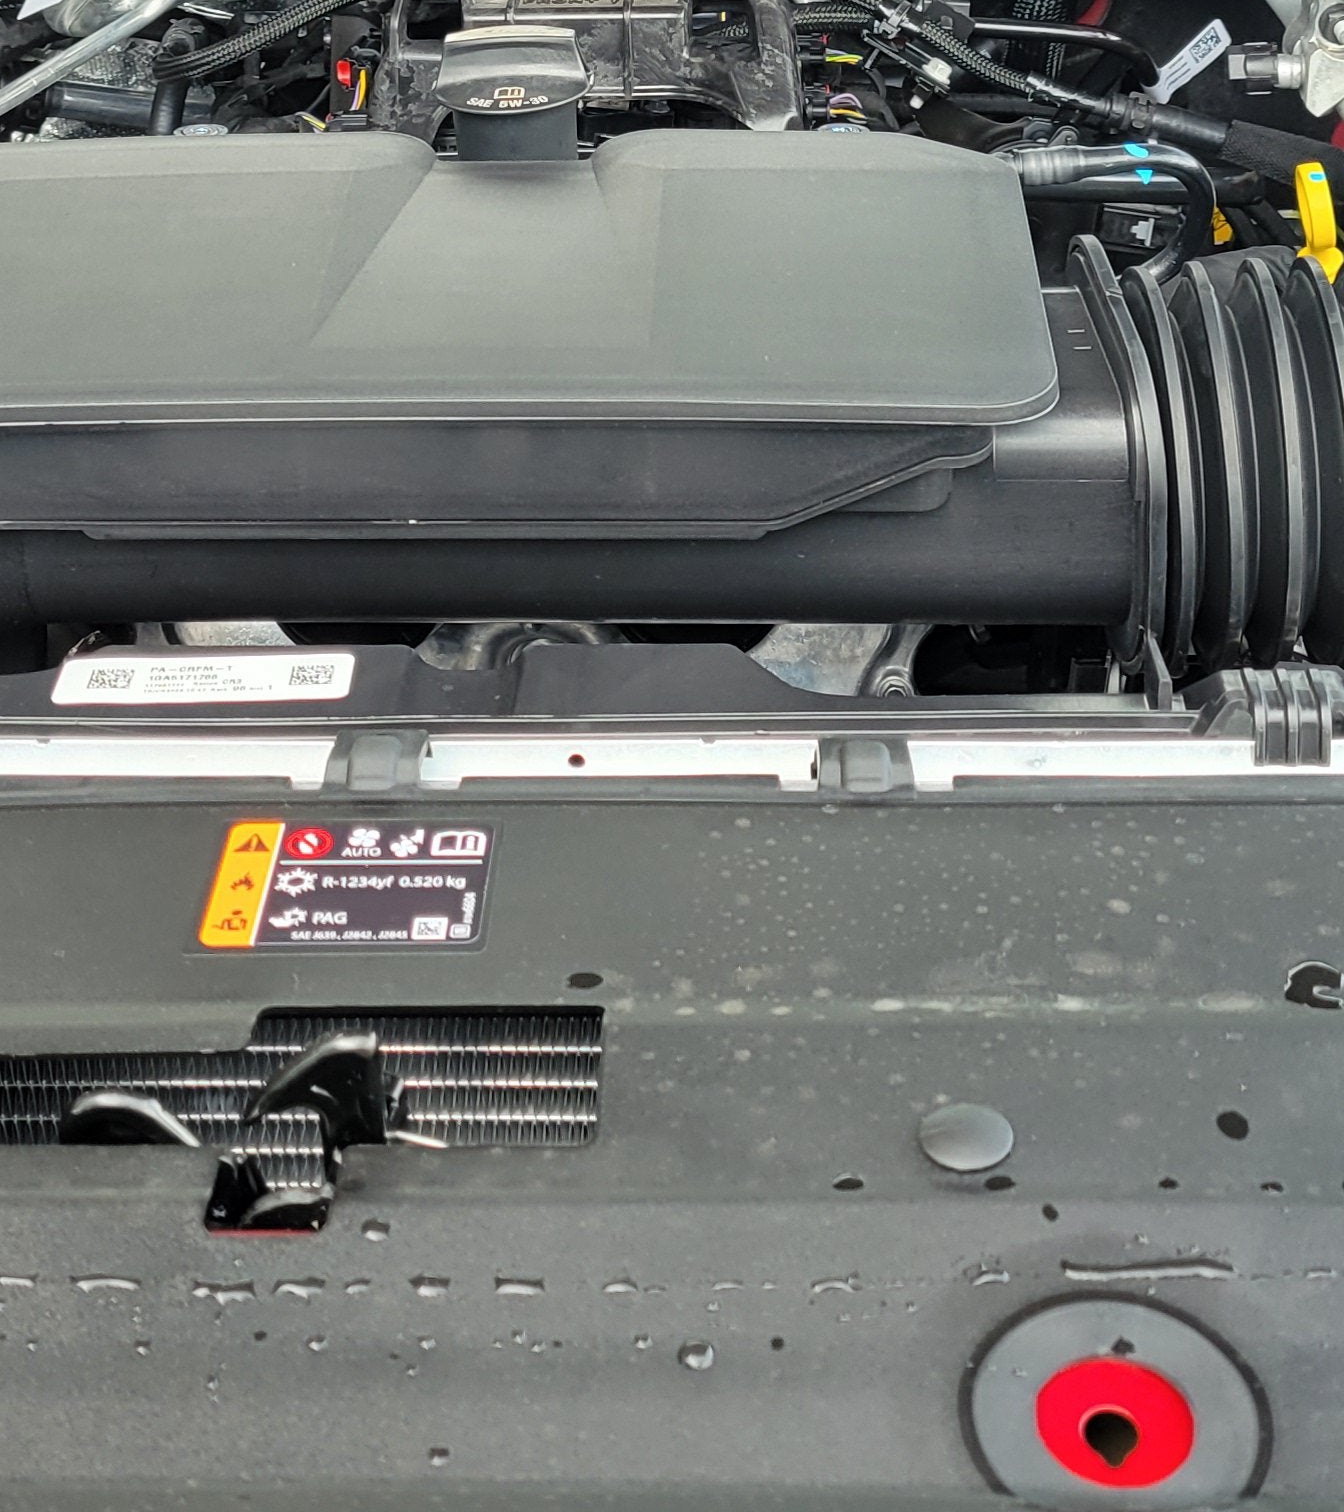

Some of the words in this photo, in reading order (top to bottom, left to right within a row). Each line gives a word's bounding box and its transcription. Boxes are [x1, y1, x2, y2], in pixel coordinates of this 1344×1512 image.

[466, 97, 494, 108] SAE
[498, 95, 549, 108] 5W-30
[341, 846, 382, 858] AUTO
[322, 875, 395, 890] R-1234yf
[398, 875, 444, 889] 0.520
[446, 874, 467, 891] kg
[311, 911, 348, 926] PAG
[290, 930, 312, 940] SAE
